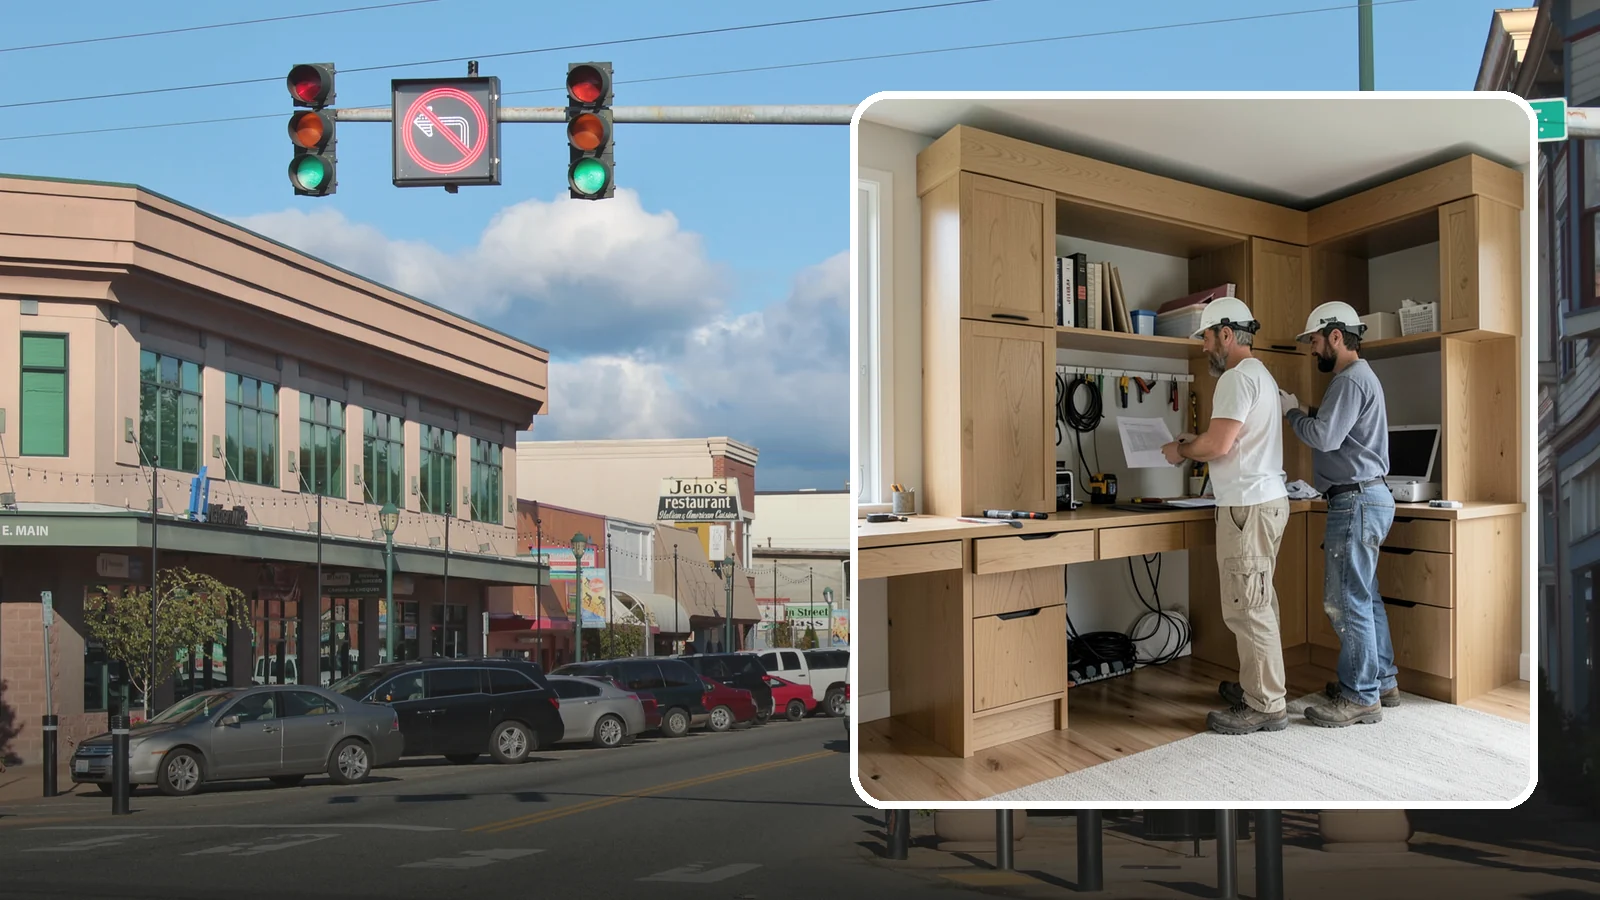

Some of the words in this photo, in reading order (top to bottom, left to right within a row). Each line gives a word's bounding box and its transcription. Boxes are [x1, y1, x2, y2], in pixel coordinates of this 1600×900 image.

[670, 480, 727, 494] Jeno's
[665, 497, 731, 509] restaurant
[659, 510, 681, 519] Italian
[686, 510, 714, 519] American
[715, 510, 738, 519] Cuisine
[2, 525, 13, 536] E.
[15, 525, 49, 536] MAIN
[797, 607, 828, 617] Street
